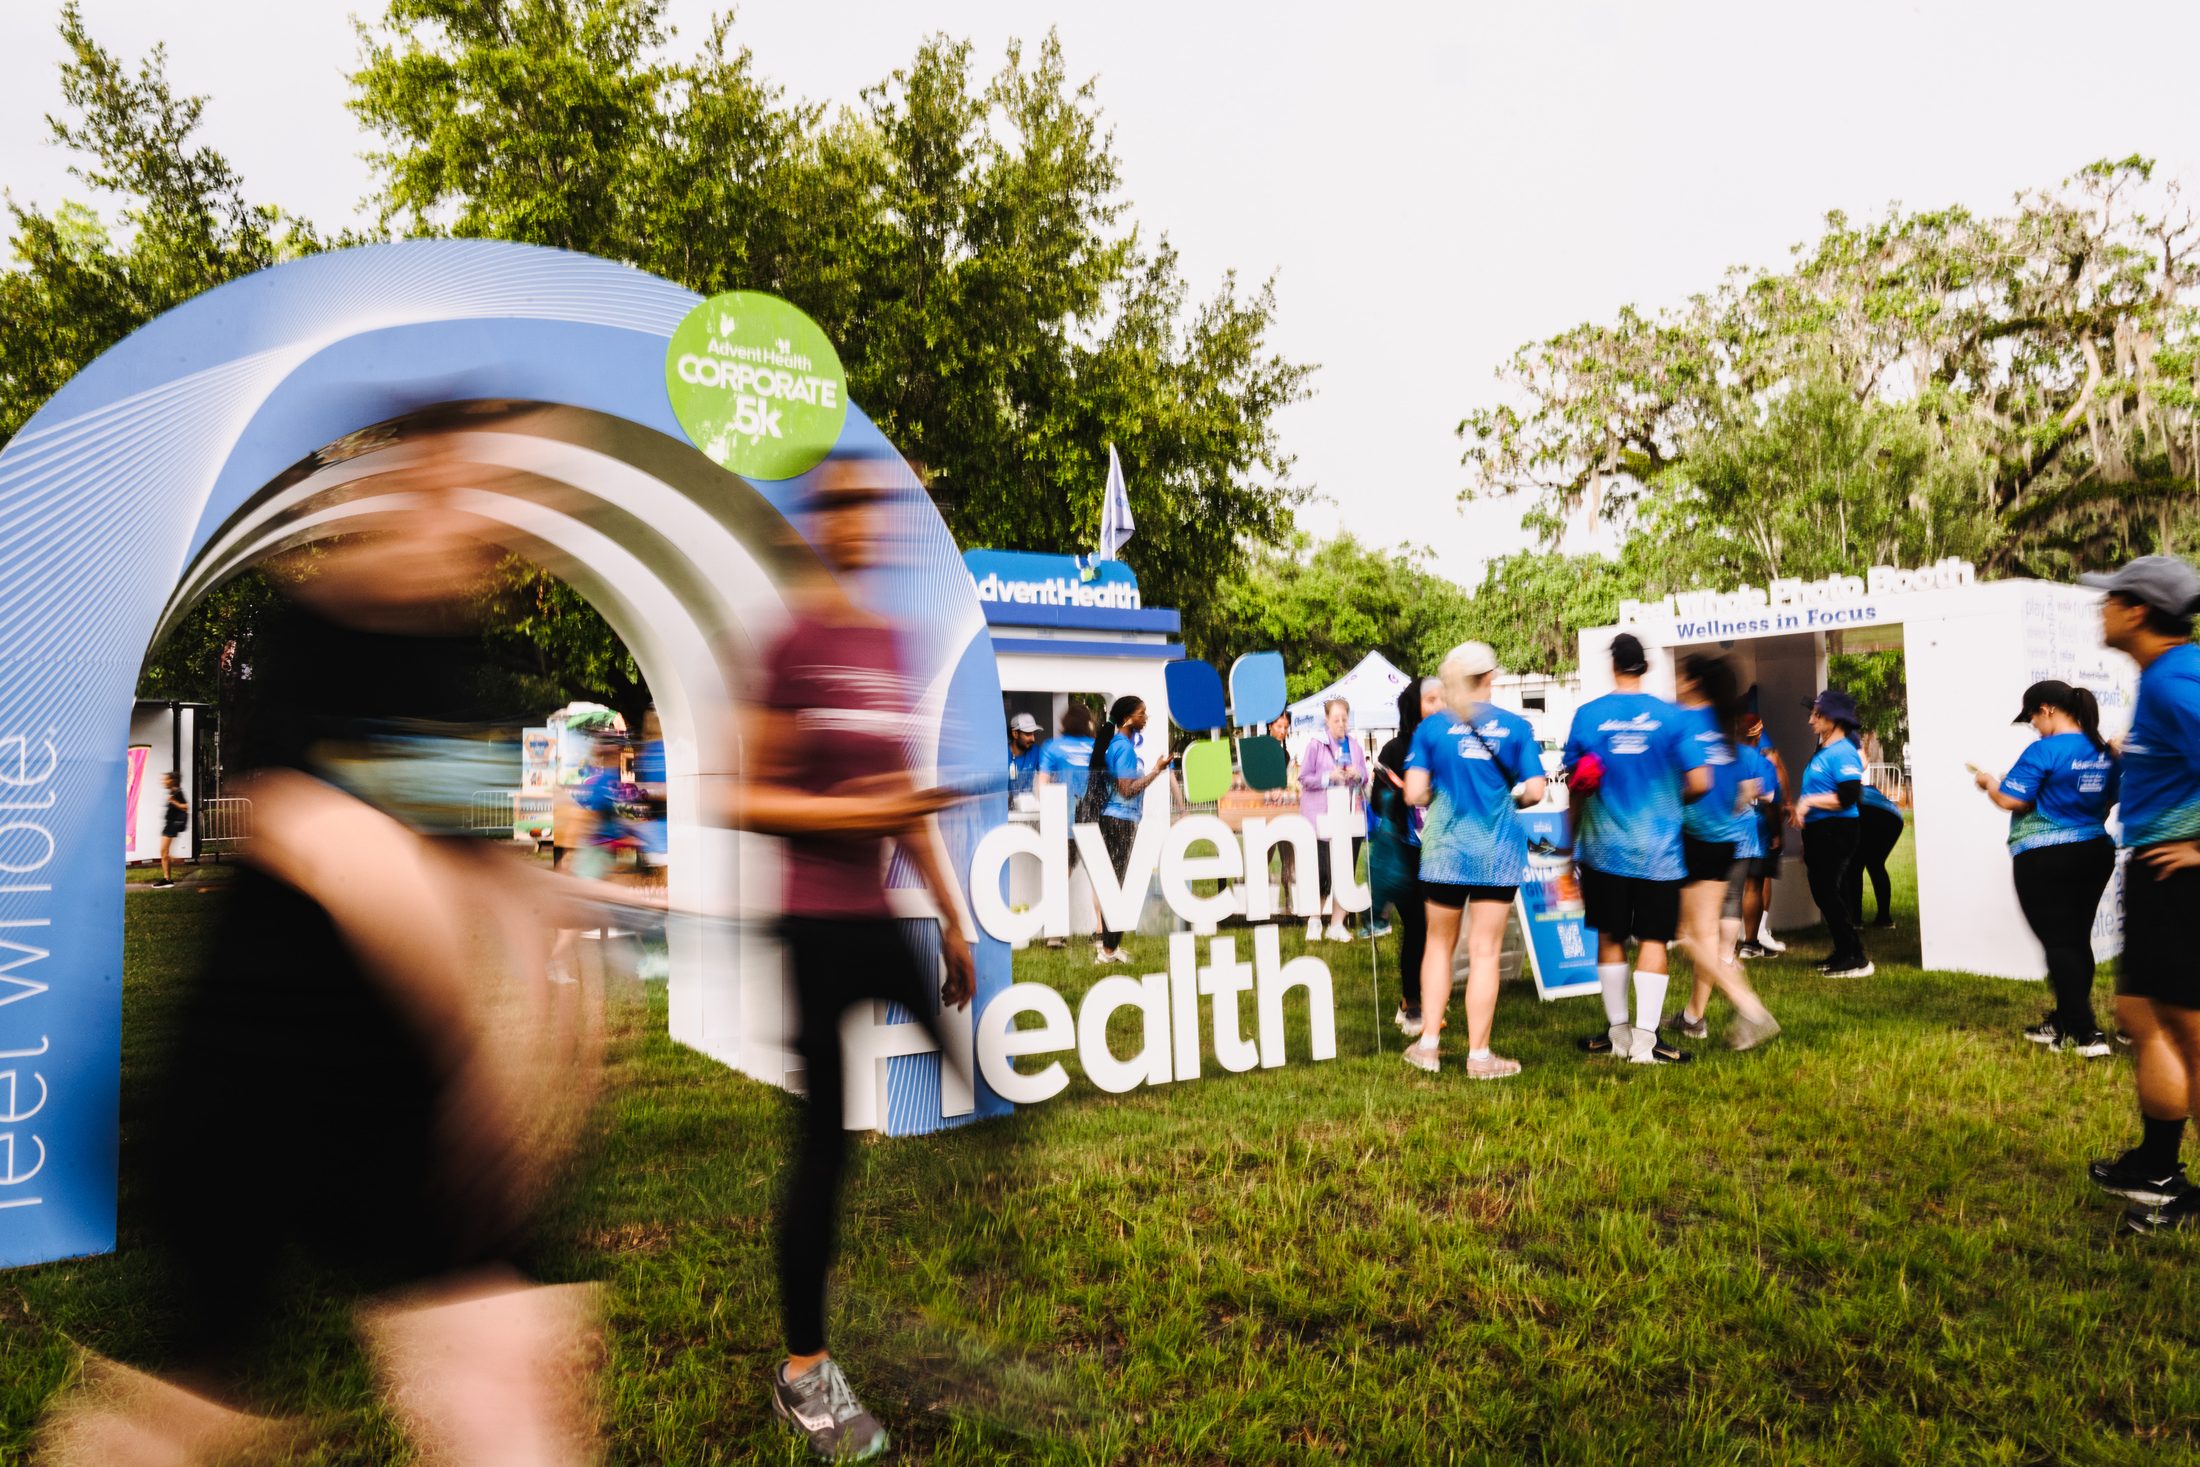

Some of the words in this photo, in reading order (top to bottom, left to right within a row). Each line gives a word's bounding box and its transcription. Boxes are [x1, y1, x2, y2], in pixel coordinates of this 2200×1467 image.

[677, 353, 838, 409] CORPORATE
[734, 394, 784, 439] 5k
[971, 573, 1141, 610] dventHealth
[1867, 555, 1975, 595] Booth
[1676, 617, 1769, 640] Wellness
[1776, 612, 1799, 629] in
[1806, 605, 1878, 626] Focus
[842, 924, 1337, 1130] Health
